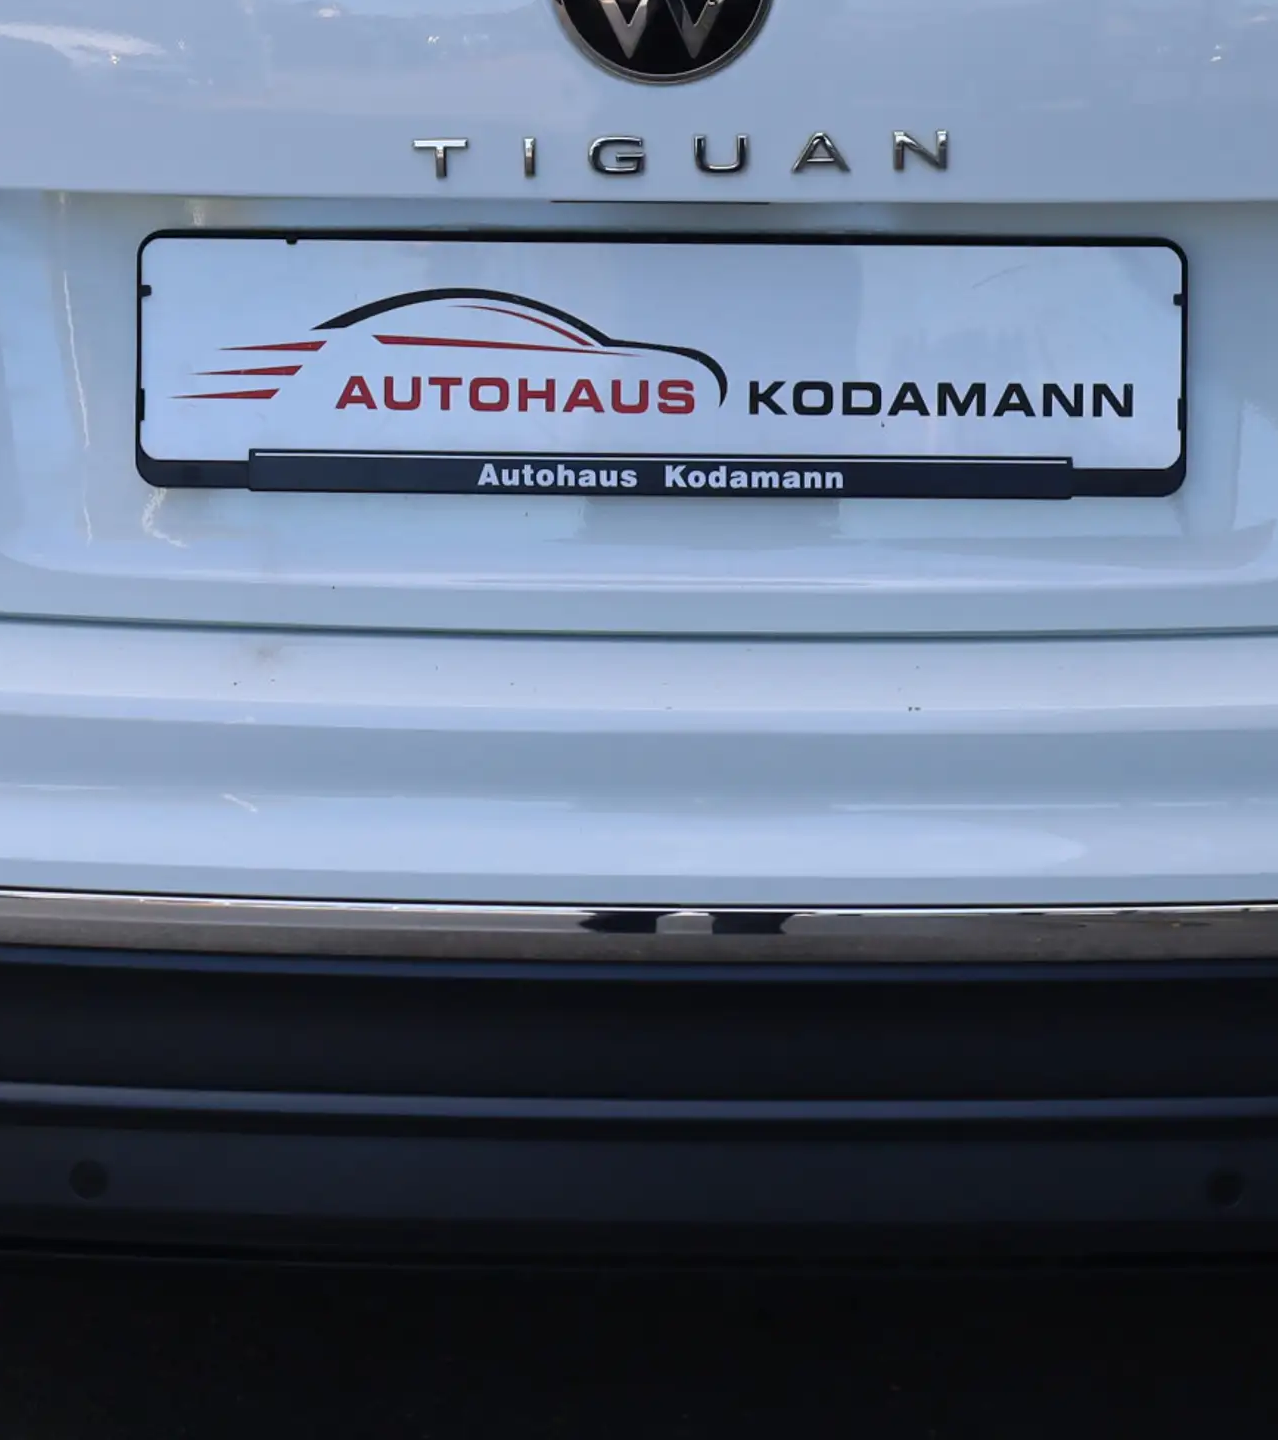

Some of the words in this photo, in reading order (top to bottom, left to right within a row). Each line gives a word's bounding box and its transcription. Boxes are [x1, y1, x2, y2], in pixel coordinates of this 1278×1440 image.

[412, 129, 951, 180] TIGUAN
[334, 372, 696, 417] AUTOHAUS
[747, 378, 1135, 420] KODAMANN
[477, 462, 639, 490] Autohaus
[663, 464, 845, 492] Kodamann
